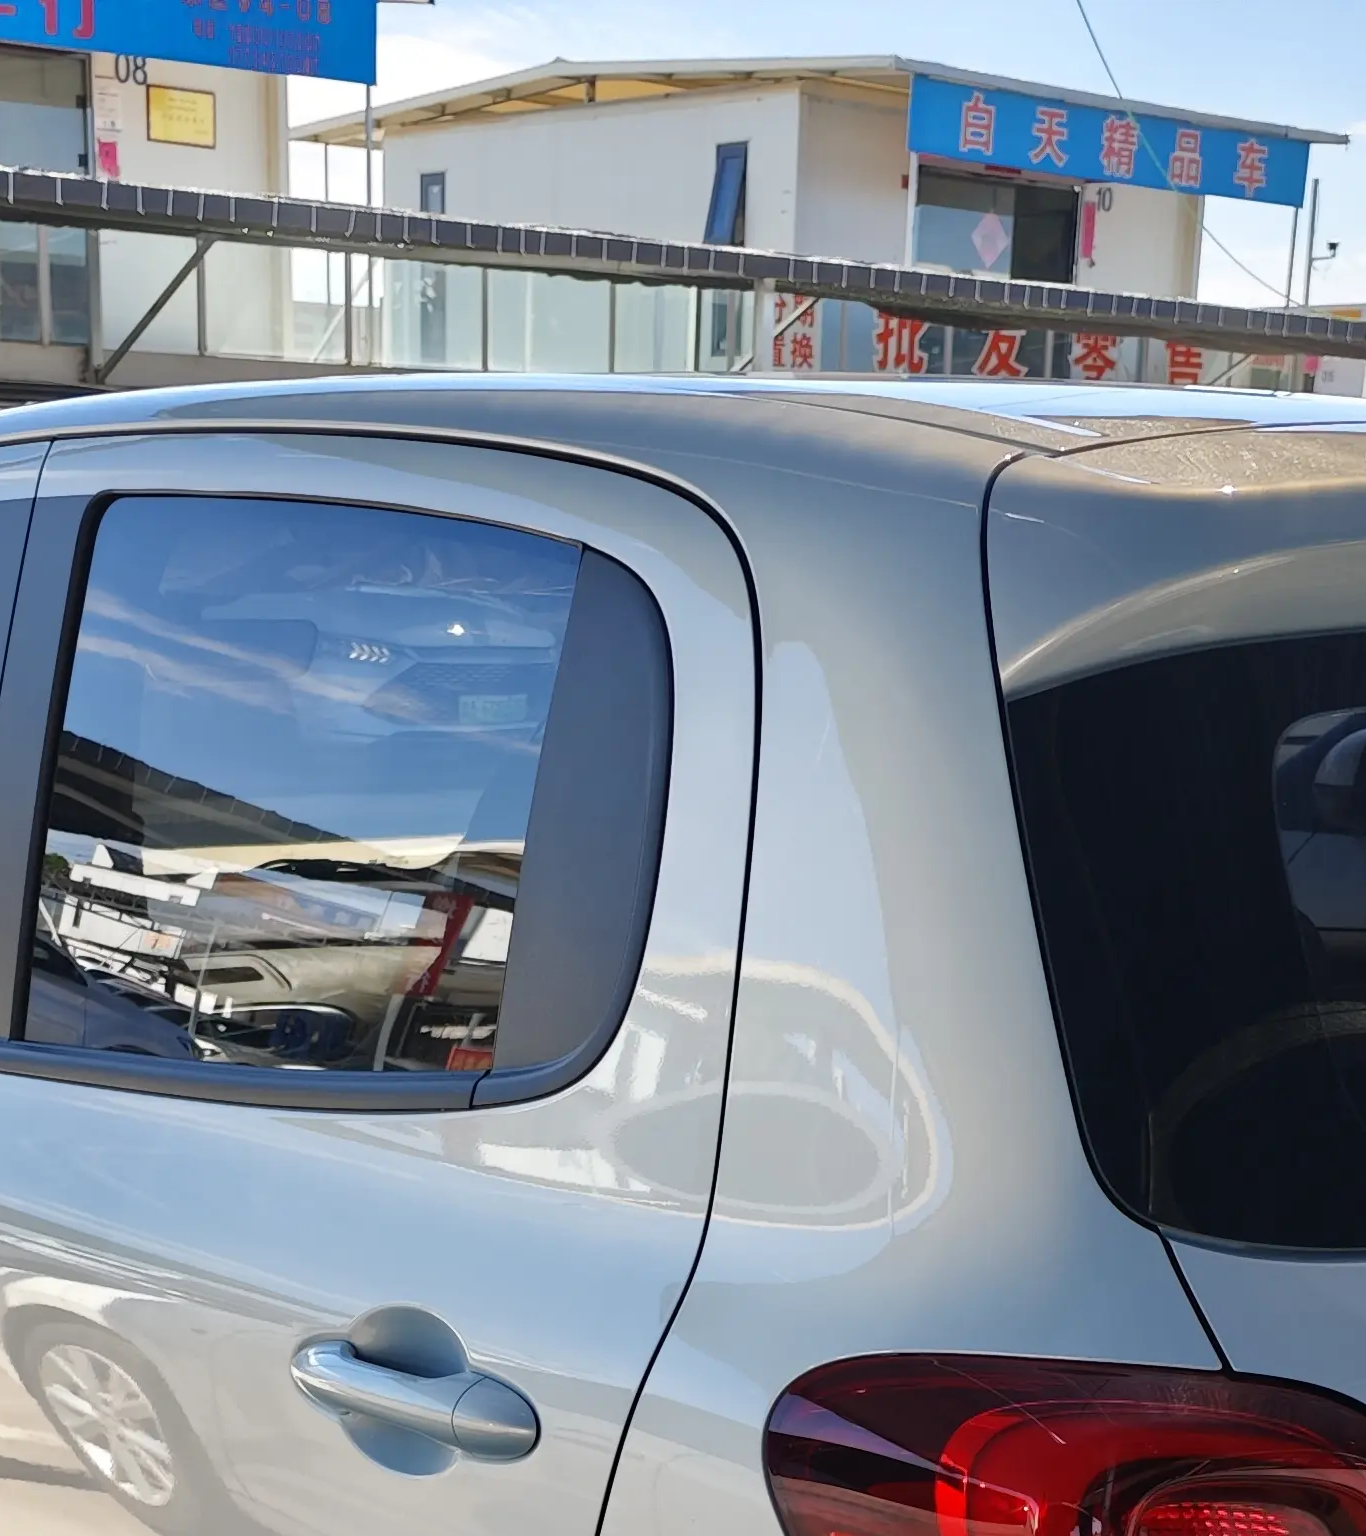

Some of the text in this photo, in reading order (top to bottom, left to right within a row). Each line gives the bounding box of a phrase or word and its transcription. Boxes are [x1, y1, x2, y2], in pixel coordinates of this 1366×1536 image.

[115, 54, 147, 85] 08
[960, 93, 1269, 197] 白天精品车
[1096, 187, 1113, 212] 10
